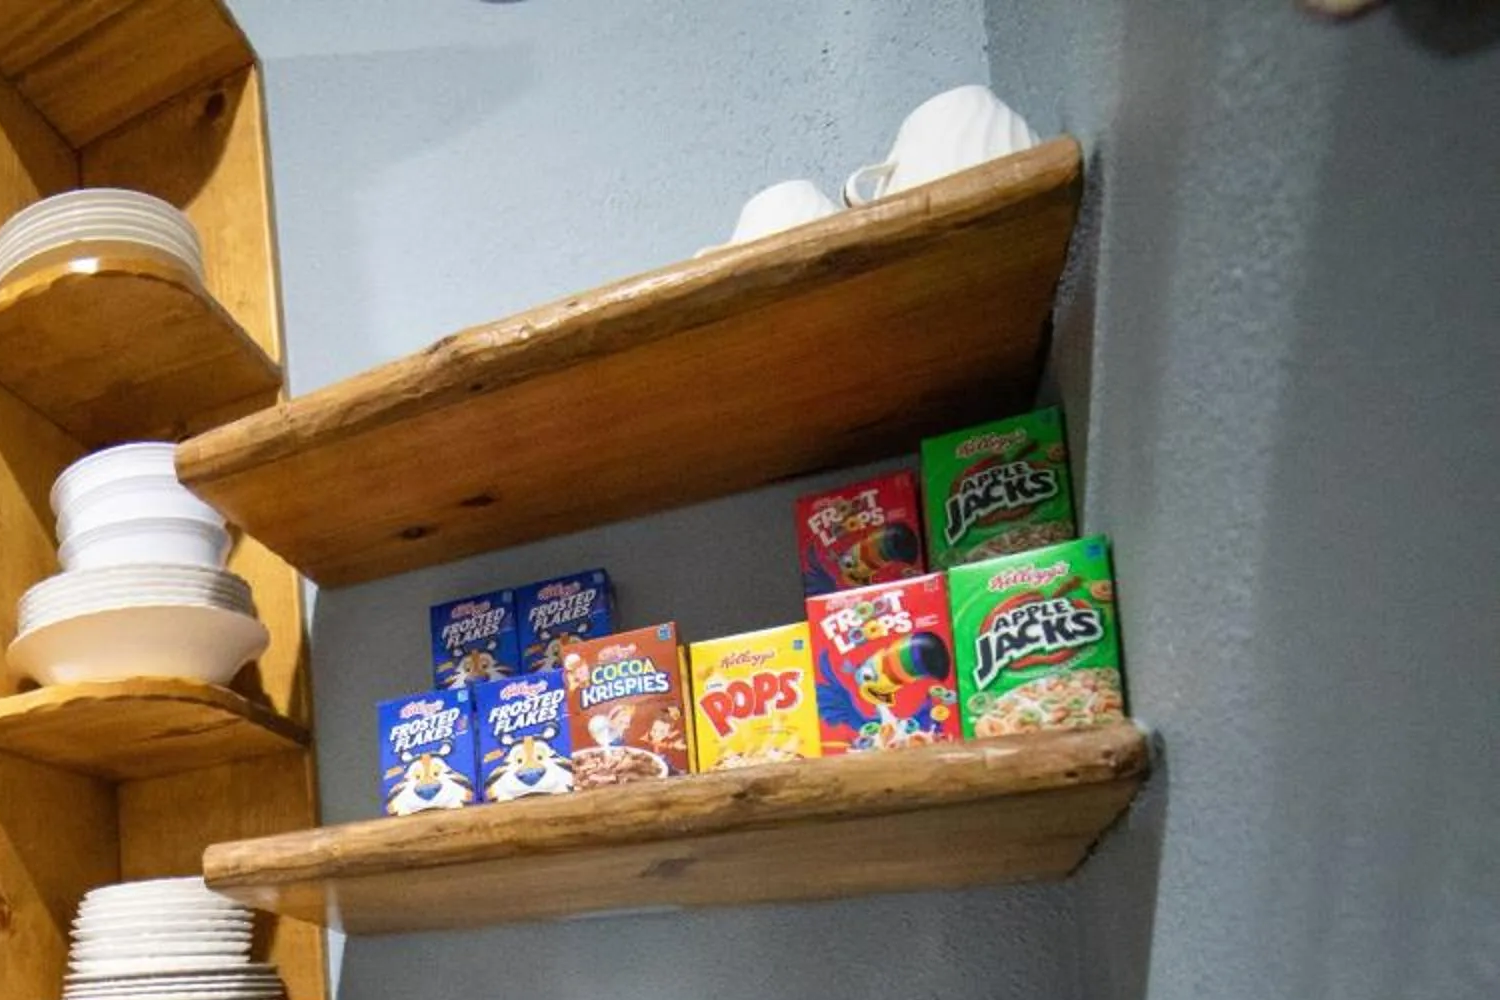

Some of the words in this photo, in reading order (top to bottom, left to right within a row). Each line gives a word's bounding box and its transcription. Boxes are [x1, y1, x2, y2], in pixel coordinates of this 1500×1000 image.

[961, 462, 1028, 491] APPLE
[946, 472, 1054, 543] JACKS
[529, 589, 596, 620] FROSTED
[533, 605, 591, 632] FLAKES
[820, 590, 904, 640] FROOT
[994, 601, 1067, 631] APPLE
[442, 607, 504, 640] FROSTED
[446, 624, 499, 650] FLAKES
[833, 612, 913, 655] LOOPS
[976, 612, 1101, 688] JACKS
[592, 659, 657, 685] COCOA
[488, 689, 565, 726] FROSTED
[581, 674, 670, 708] KRISPIES
[700, 671, 801, 738] POPS
[390, 708, 461, 742] FROSTED
[494, 706, 558, 736] FLAKES
[395, 725, 453, 752] FLAKES
